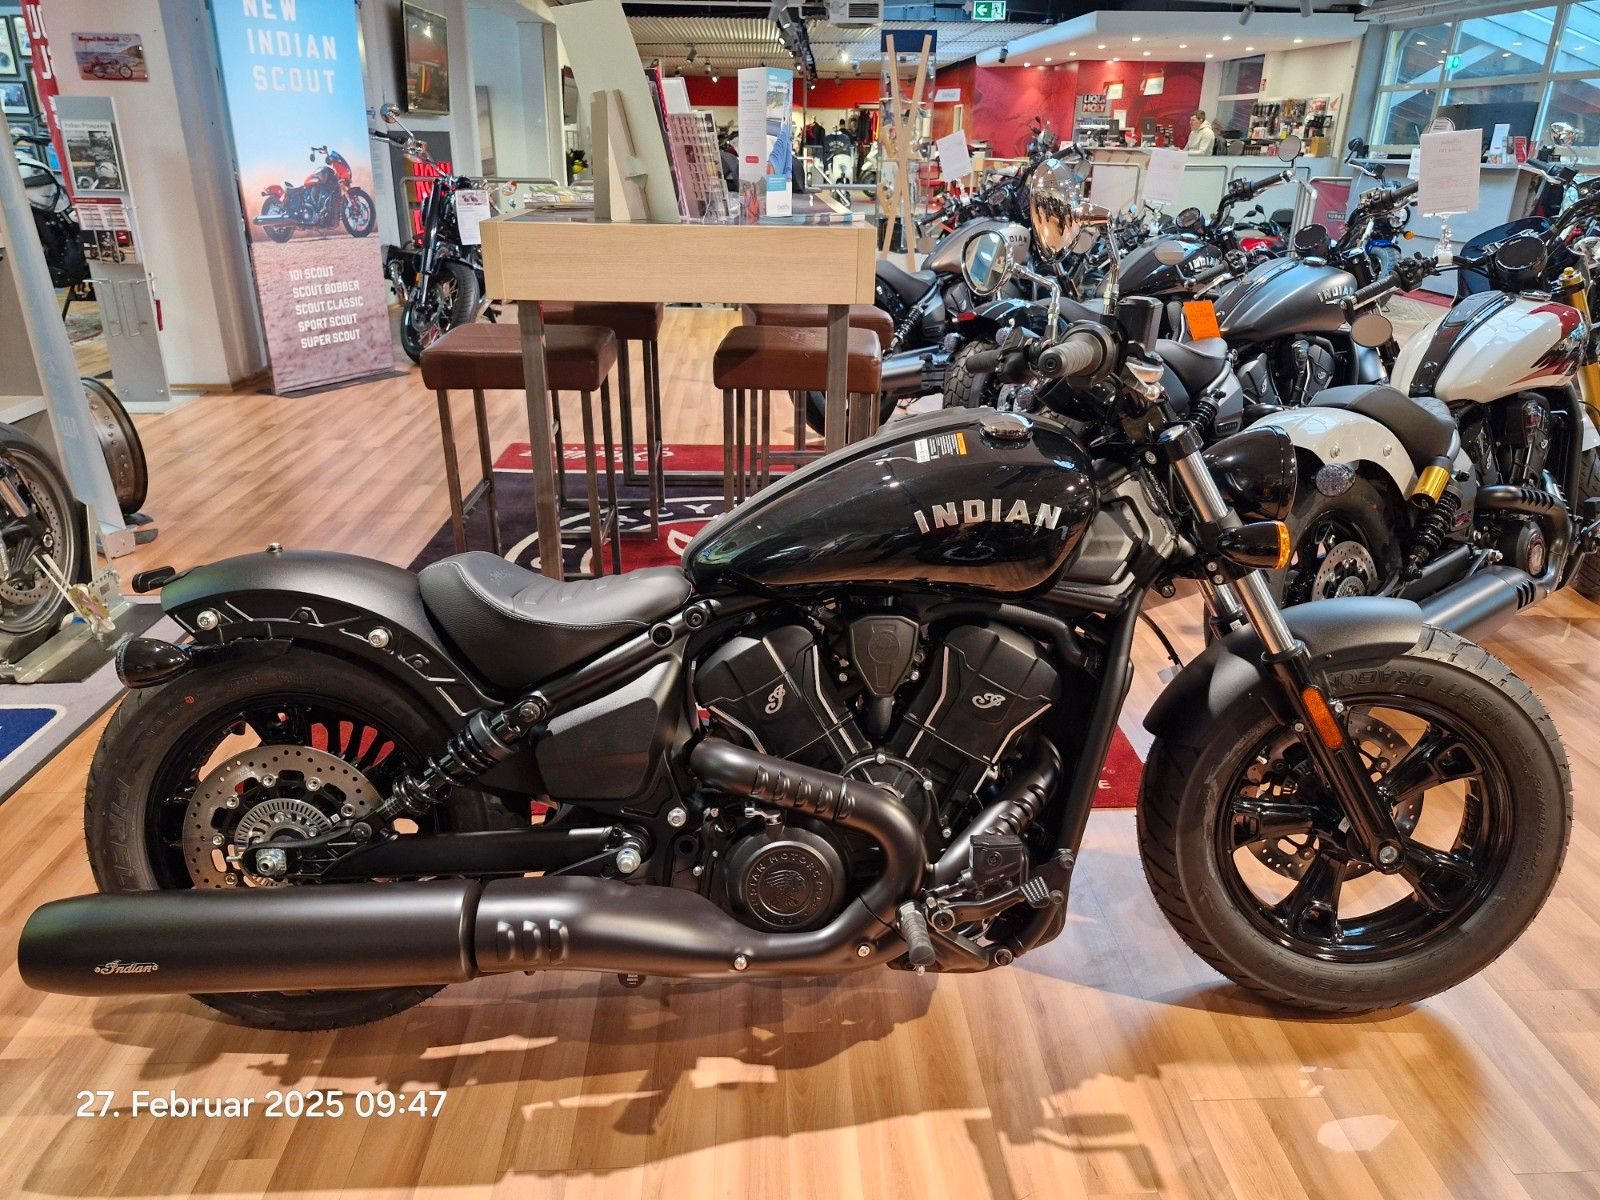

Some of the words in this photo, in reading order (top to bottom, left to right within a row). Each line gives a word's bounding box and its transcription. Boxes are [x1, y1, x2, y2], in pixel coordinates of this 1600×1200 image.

[242, 0, 297, 21] NEW
[247, 27, 337, 60] INDIAN
[252, 64, 335, 94] SCOUT
[304, 266, 334, 280] SCOUT
[292, 283, 322, 299] SCOUT
[324, 280, 360, 295] BOBBER
[295, 301, 325, 316] SCOUT
[326, 296, 364, 311] CLASSIC
[297, 317, 328, 332] SPORT
[329, 313, 358, 327] SCOUT
[300, 334, 331, 349] SUPER
[332, 329, 361, 343] SCOUT
[913, 499, 1063, 534] INDIAN
[95, 960, 159, 975] Indian
